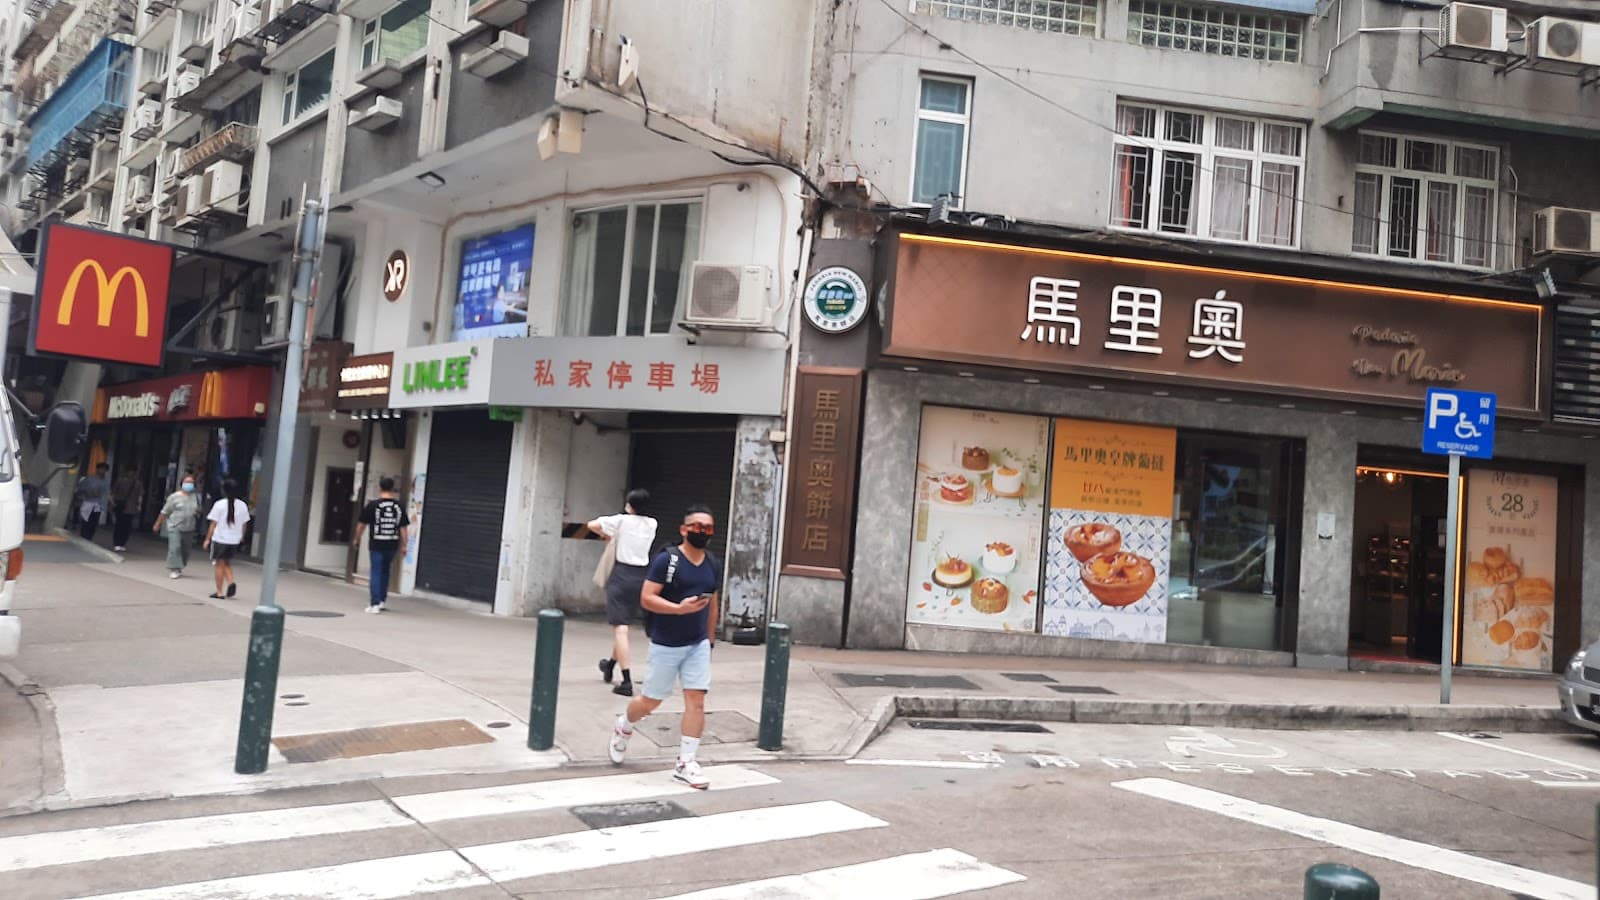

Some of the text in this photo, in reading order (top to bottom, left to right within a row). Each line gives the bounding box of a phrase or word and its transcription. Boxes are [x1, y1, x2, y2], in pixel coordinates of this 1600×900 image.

[1020, 276, 1246, 362] 馬里奧
[402, 355, 471, 392] LINLEE
[533, 359, 721, 394] 私家停車場
[1428, 392, 1458, 429] P
[1436, 440, 1480, 453] RESERVADO
[801, 389, 840, 551] 馬里奧餅店
[1501, 492, 1525, 514] 28
